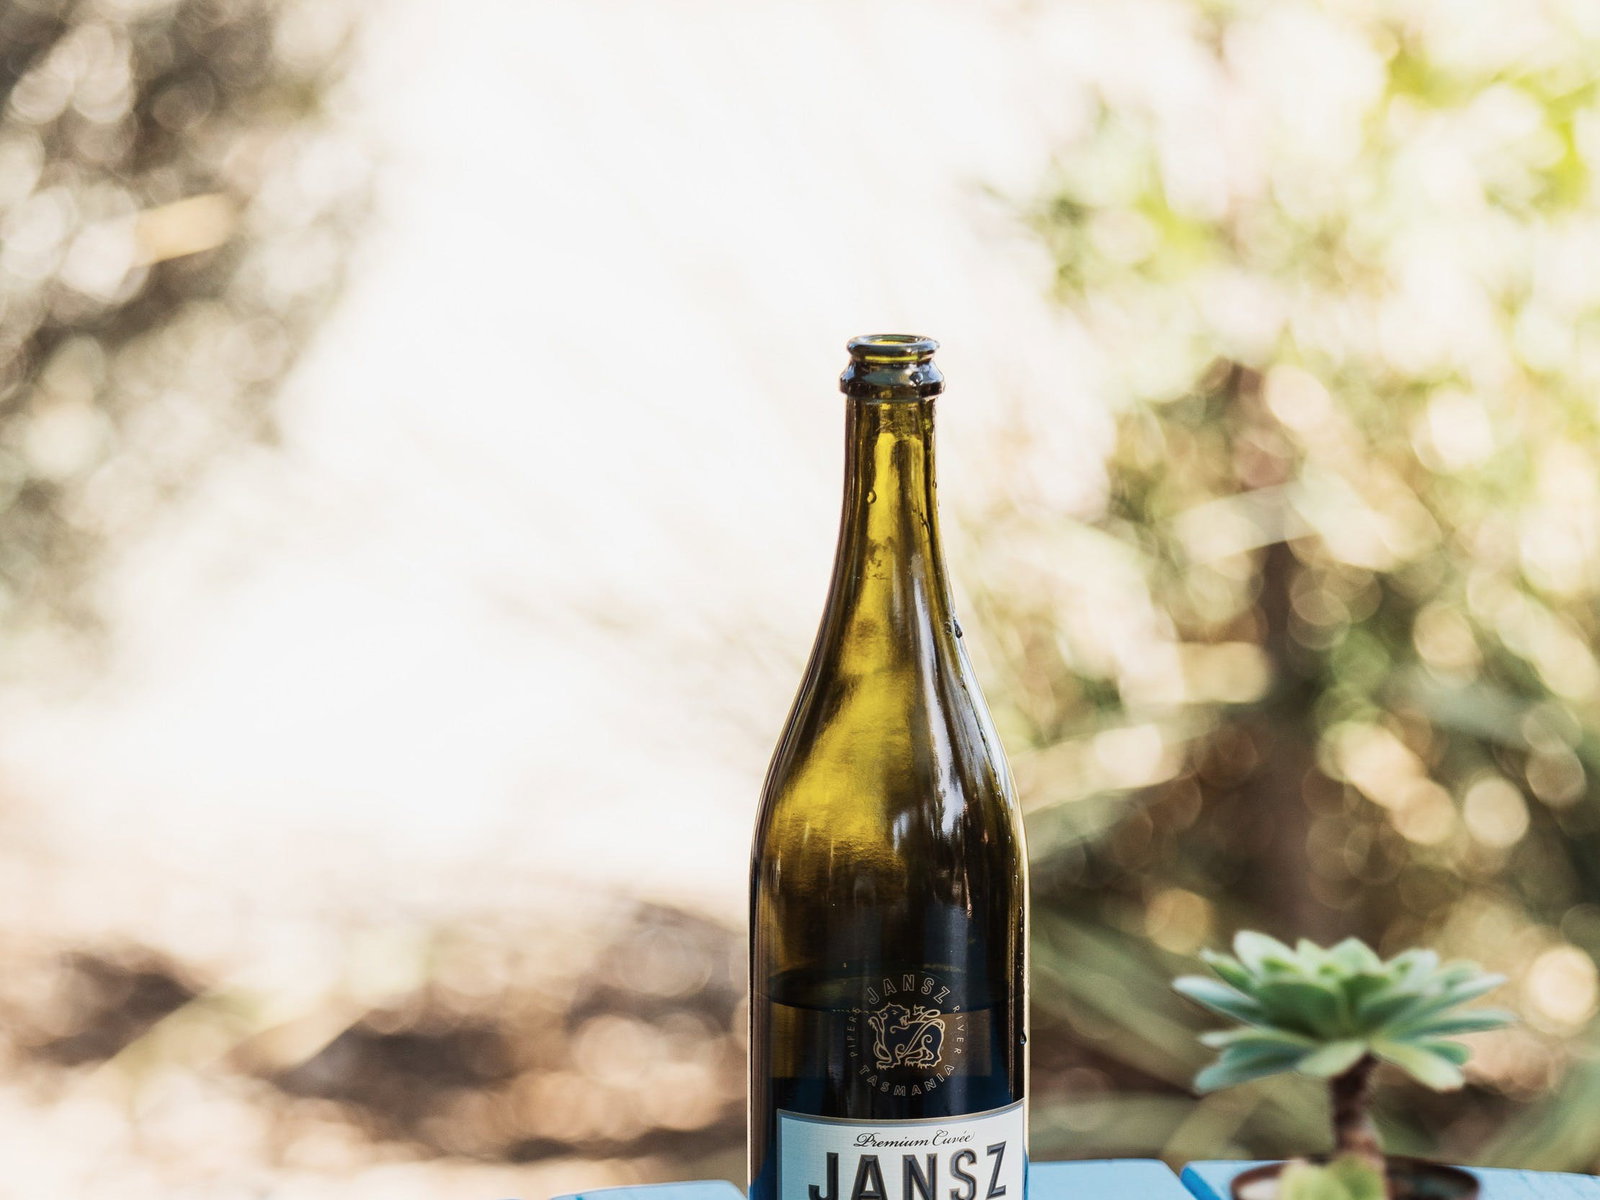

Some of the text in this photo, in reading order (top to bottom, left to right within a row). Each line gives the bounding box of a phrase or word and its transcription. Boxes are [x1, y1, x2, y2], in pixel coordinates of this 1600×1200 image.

[867, 974, 950, 1004] JANSZ
[953, 1005, 965, 1054] RIVER
[859, 1064, 955, 1096] TASMANIA
[853, 1129, 975, 1148] Premium Cuvée
